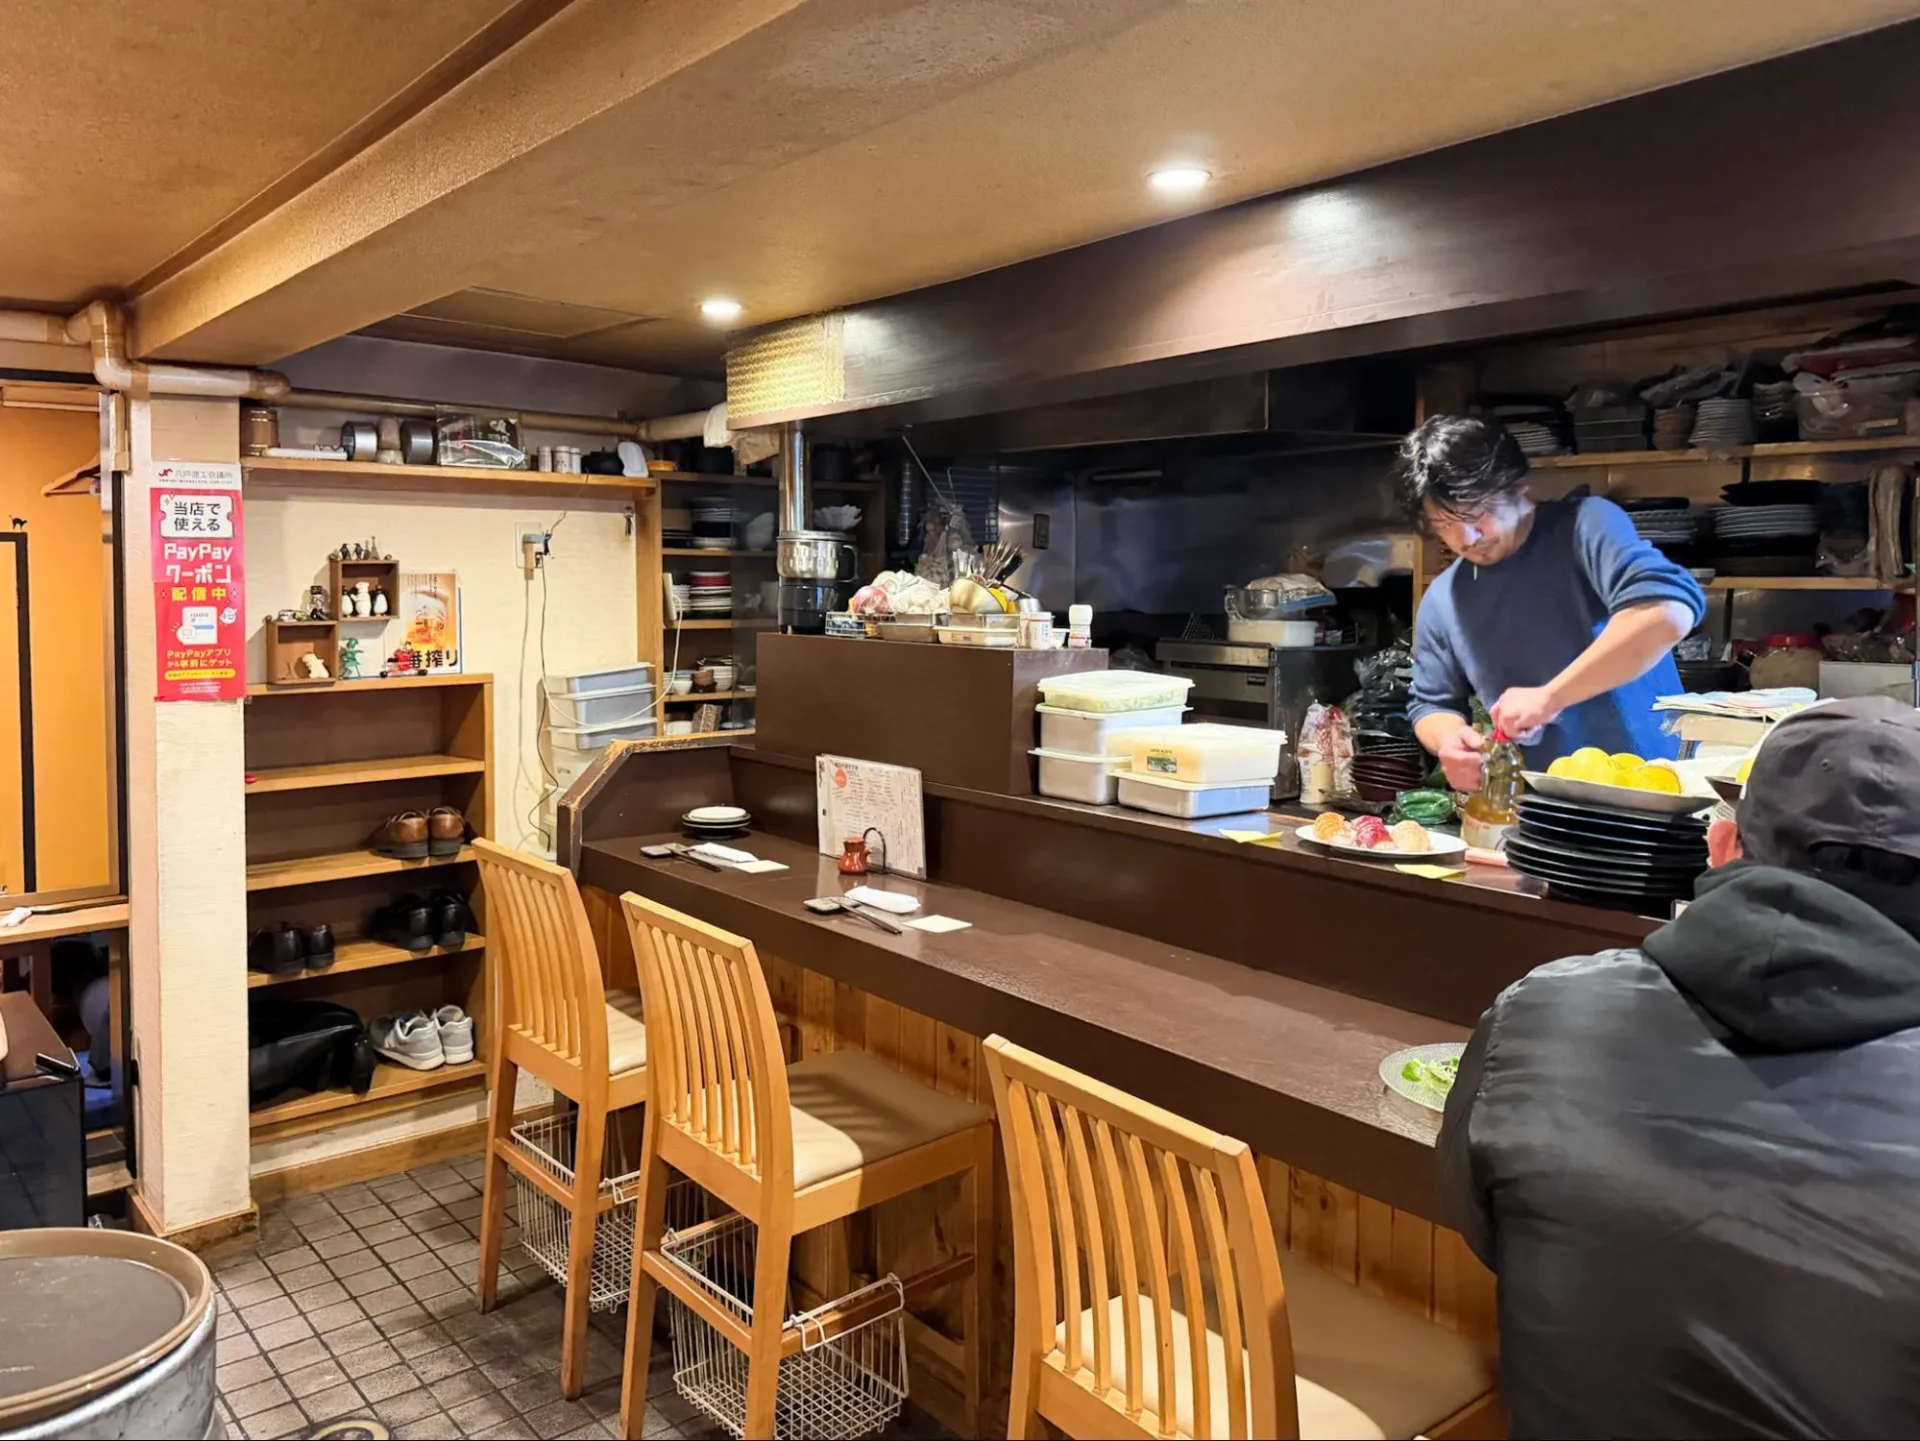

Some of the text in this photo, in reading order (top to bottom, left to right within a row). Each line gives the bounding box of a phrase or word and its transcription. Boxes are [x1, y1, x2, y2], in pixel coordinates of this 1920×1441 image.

[174, 501, 220, 516] 当店で
[174, 517, 220, 531] 使える
[164, 543, 234, 562] PayPay
[166, 563, 231, 584] クーポン
[171, 587, 226, 601] 配信中
[167, 648, 231, 659] PayPayアプリ
